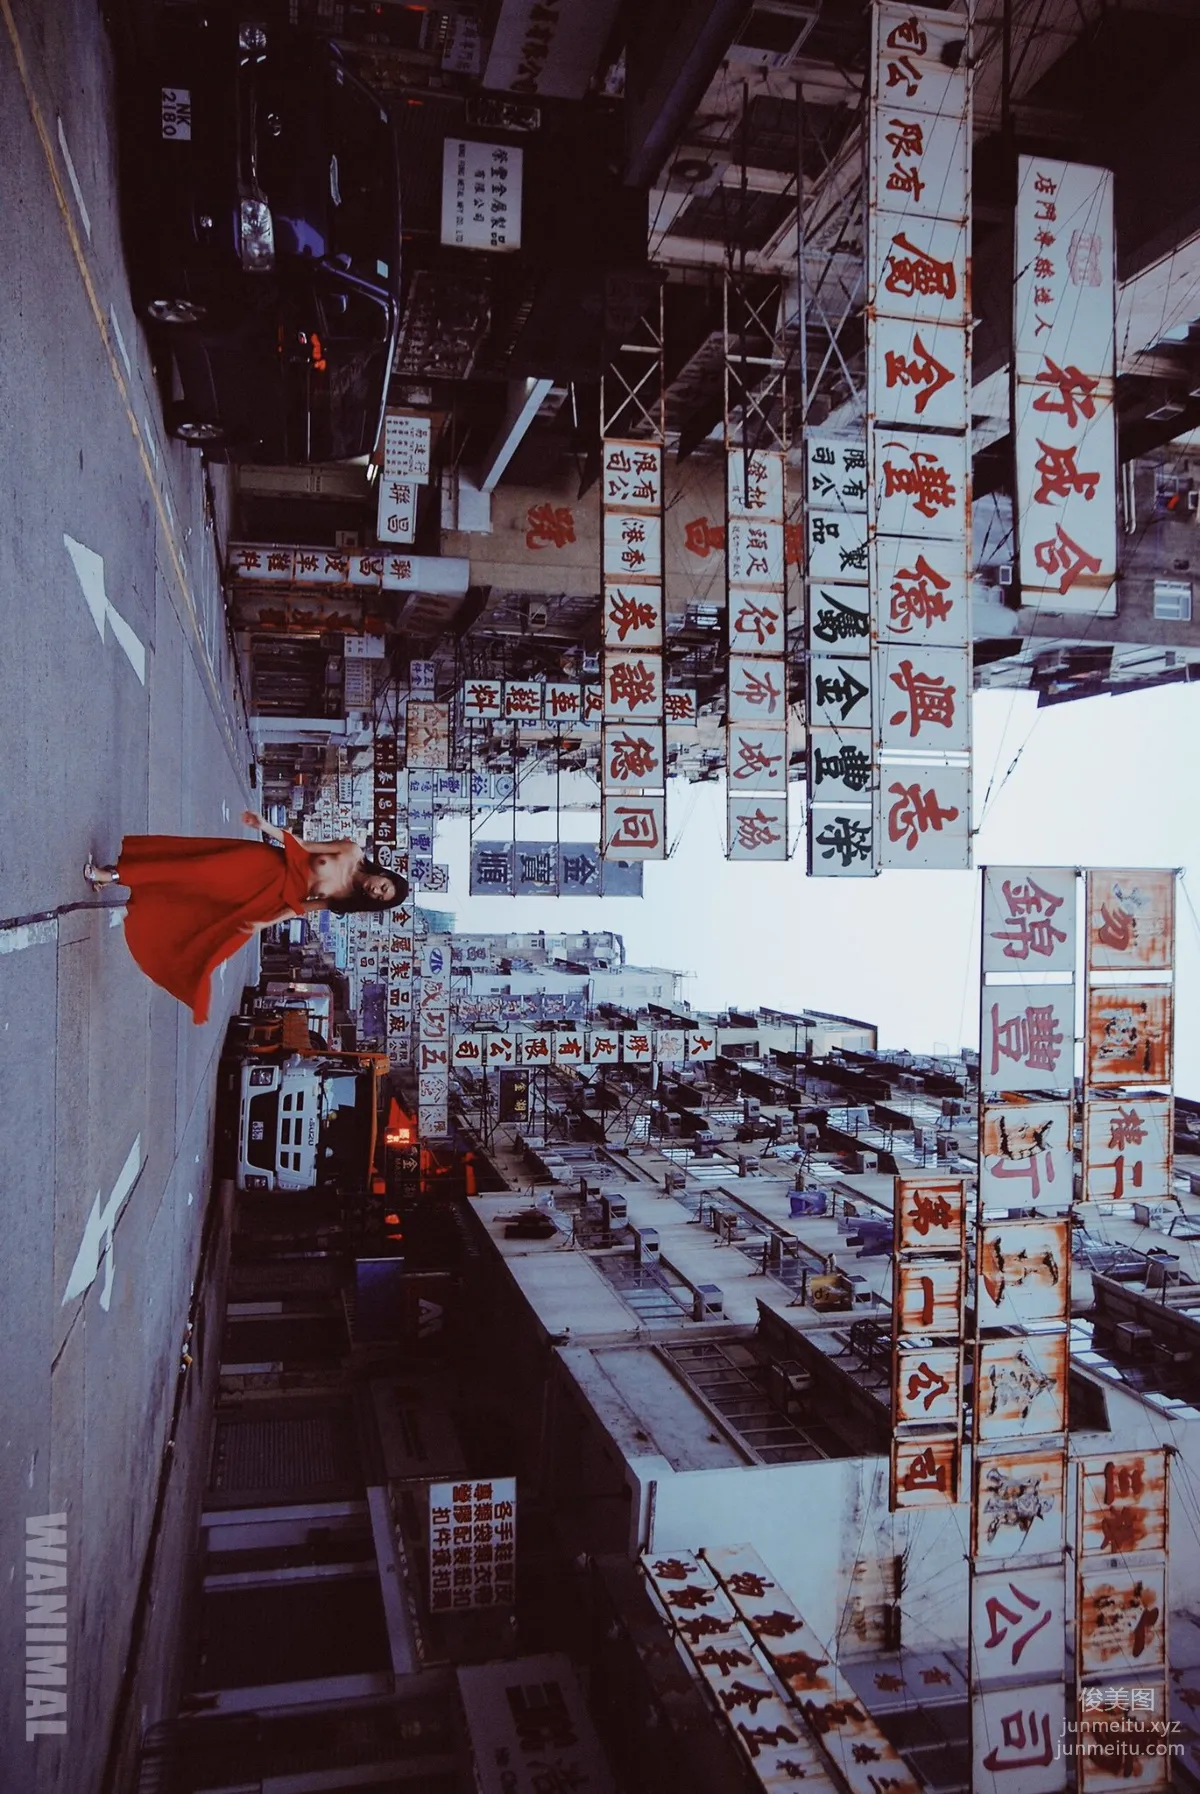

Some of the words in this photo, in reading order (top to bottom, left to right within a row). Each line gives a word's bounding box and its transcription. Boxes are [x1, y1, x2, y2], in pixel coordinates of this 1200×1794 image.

[163, 91, 177, 136] 2180
[177, 103, 191, 125] NK
[473, 170, 486, 222] 有限公司
[491, 148, 508, 246] 榮豐金屬製品
[387, 483, 411, 533] 聯昌
[240, 551, 411, 580] 聯昌皮革鞋料
[477, 851, 596, 886] 金寶順
[904, 1190, 954, 1492] 第一公司
